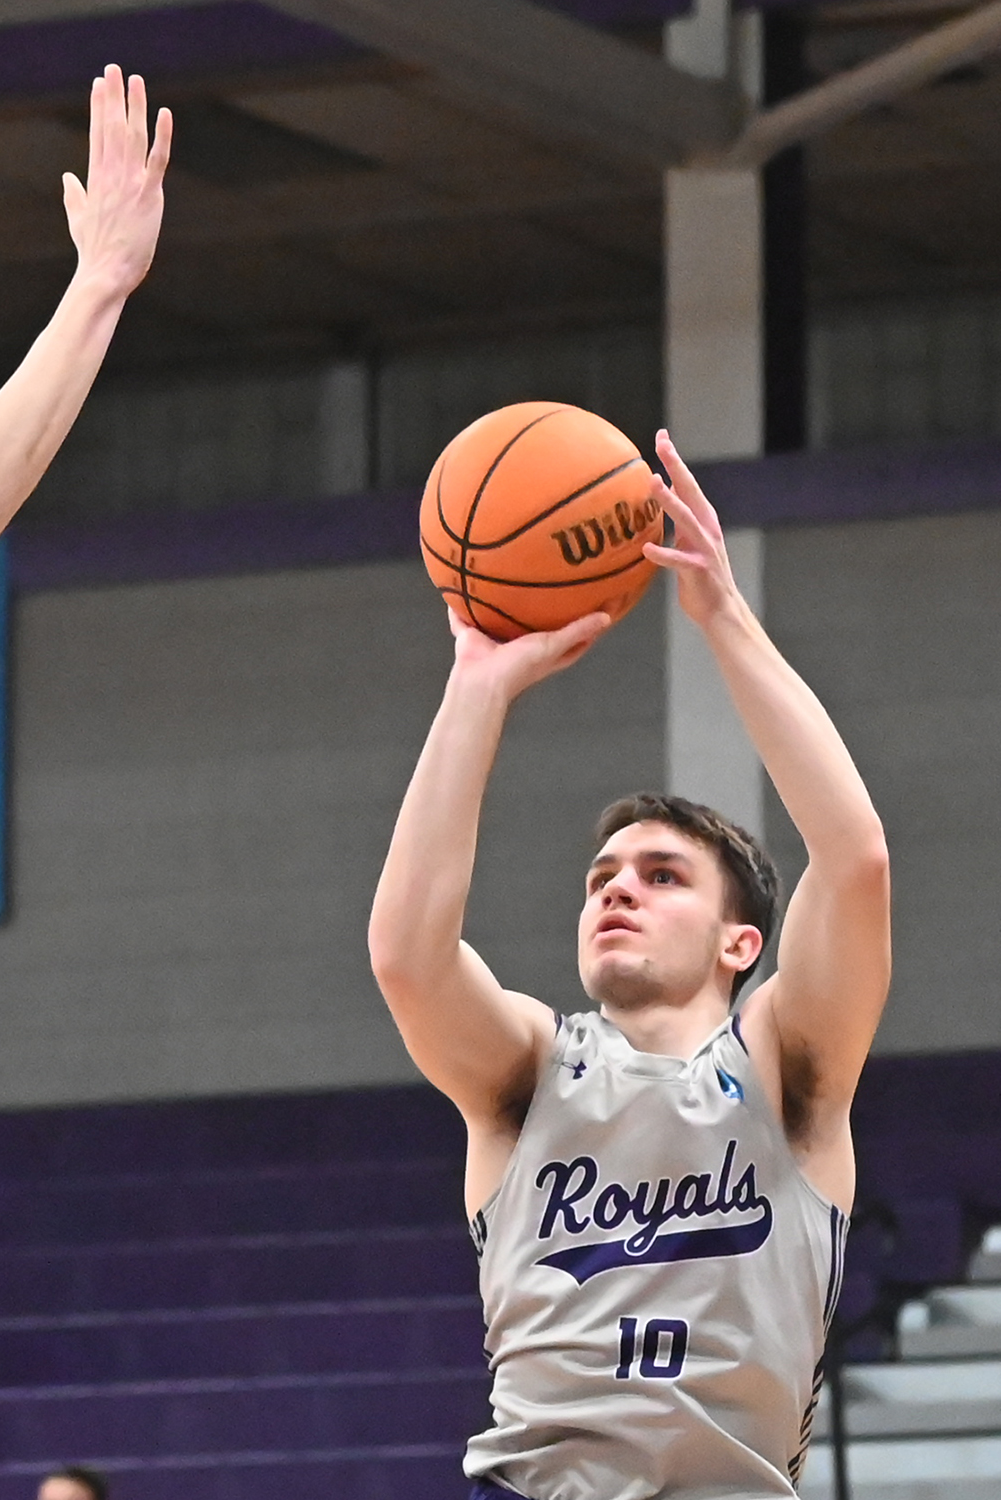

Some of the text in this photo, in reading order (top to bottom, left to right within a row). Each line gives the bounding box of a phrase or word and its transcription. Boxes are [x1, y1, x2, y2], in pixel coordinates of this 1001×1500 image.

[550, 499, 661, 566] Wilso
[534, 1139, 769, 1258] Royals
[615, 1316, 689, 1380] 10
